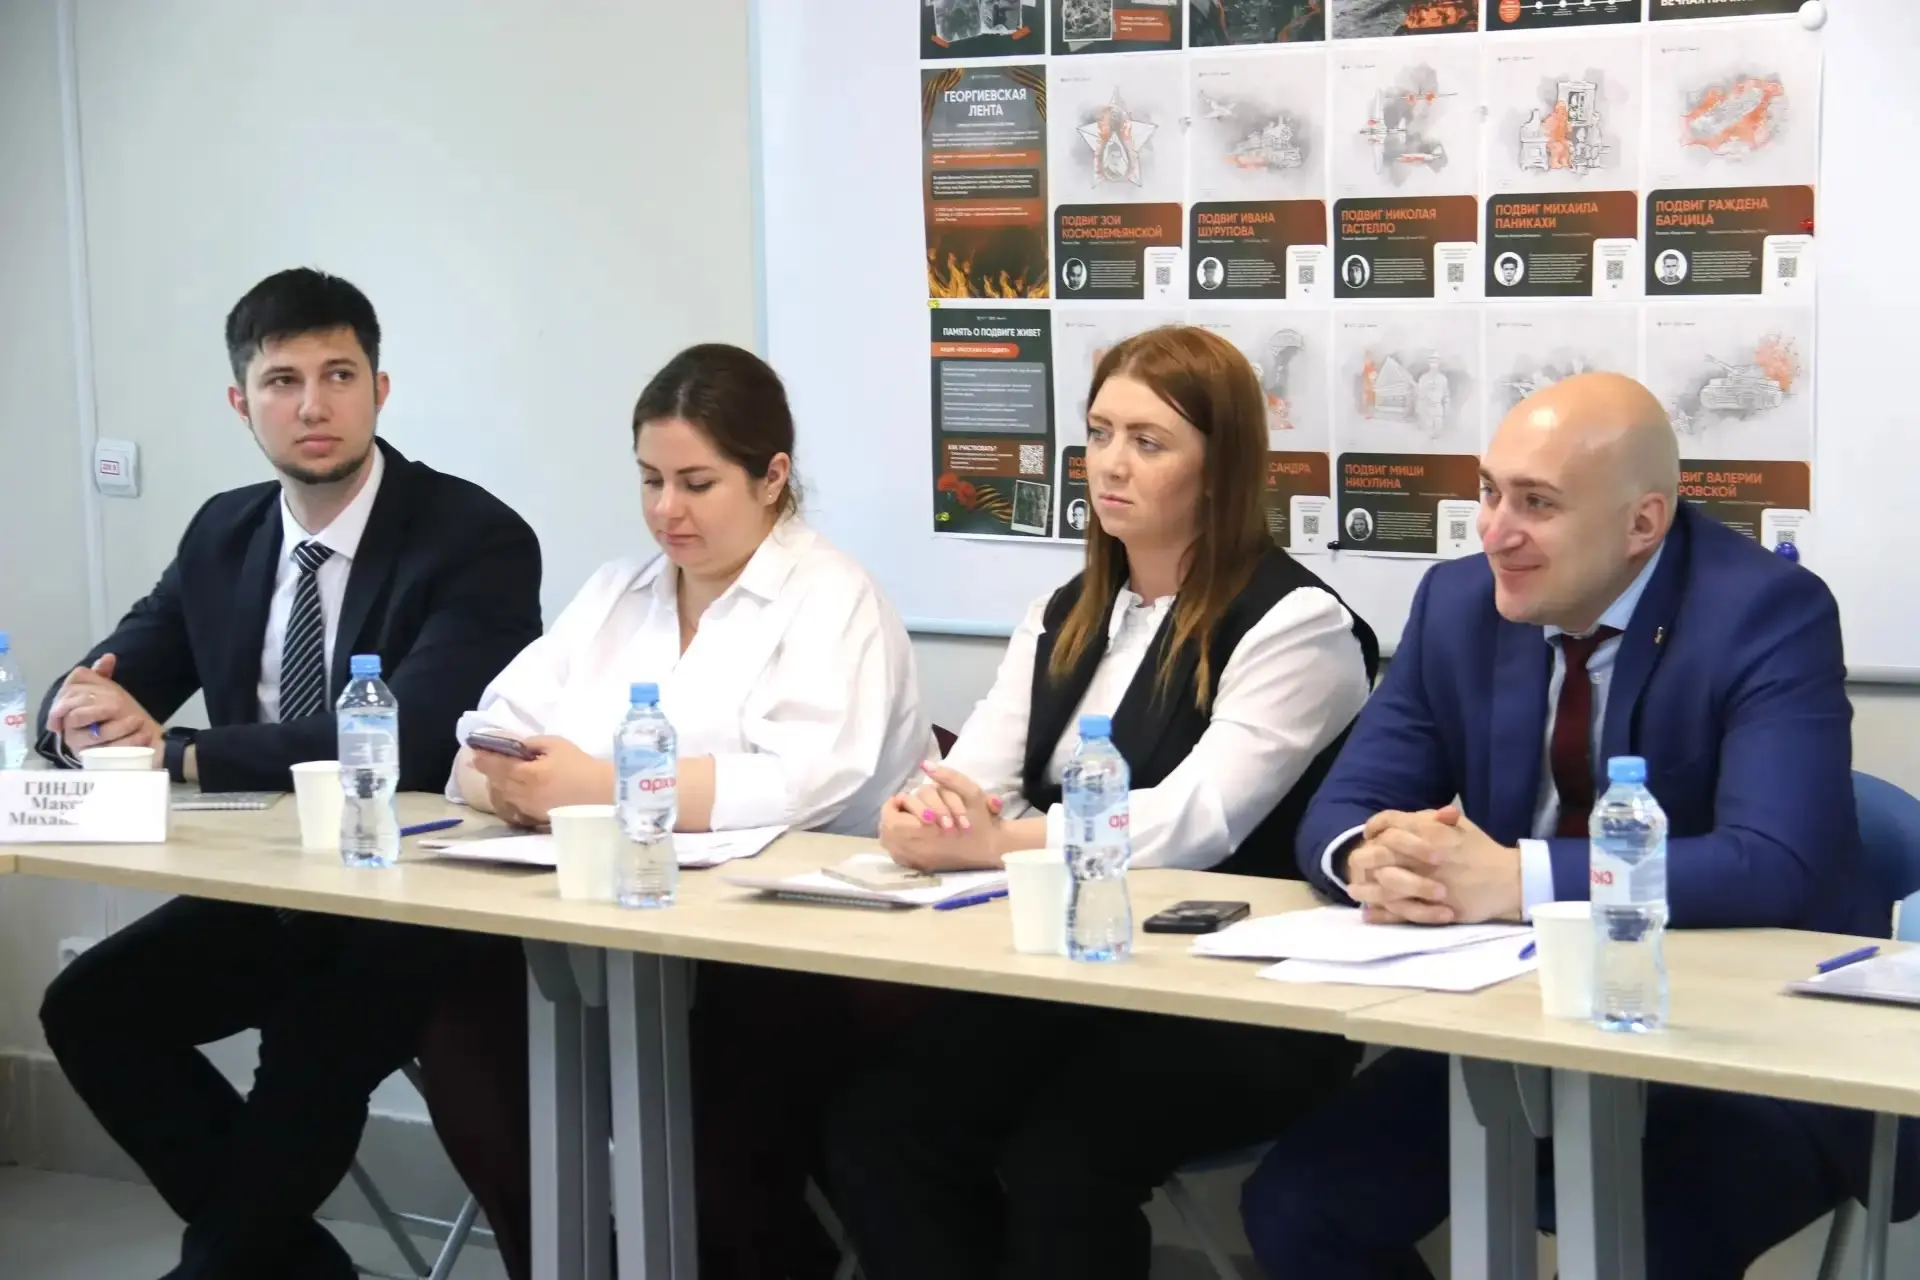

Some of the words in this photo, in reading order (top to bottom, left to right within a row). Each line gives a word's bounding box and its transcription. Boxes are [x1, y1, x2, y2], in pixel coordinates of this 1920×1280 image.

[944, 88, 1027, 103] ГЕОРГИЕВСКАЯ
[968, 104, 1004, 116] ЛЕНТА
[1495, 204, 1541, 216] ПОДВИГ
[1543, 202, 1599, 214] МИХАИЛА
[1655, 200, 1706, 213] ПОДВИГ
[1708, 198, 1769, 212] РАЖДЕНА
[1062, 216, 1098, 226] ПОДВИГ
[1101, 216, 1121, 225] ЗОИ
[1198, 213, 1238, 224] ПОДВИГ
[1241, 212, 1275, 224] ИВАНА
[1341, 210, 1382, 222] ПОДВИГ
[1385, 208, 1437, 220] НИКОЛАЯ
[1655, 214, 1714, 227] БАРЦИЦА
[1341, 223, 1396, 234] ГАСТЕЛЛО
[1495, 217, 1557, 229] ПАНИКАХИ
[1062, 225, 1162, 239] КОСМОДЕМЬЯНСКОЙ
[1198, 226, 1255, 237] ШУРУПОВА
[943, 328, 973, 337] ПАМЯТЬ
[973, 328, 980, 337] О
[981, 328, 1015, 338] ПОДВИГЕ
[1016, 328, 1041, 337] ЖИВЕТ
[1268, 462, 1312, 474] САНДРА
[1345, 464, 1386, 476] ПОДВИГ
[1389, 465, 1424, 476] МИШИ
[1345, 477, 1402, 488] НИКУЛИНА
[1679, 472, 1704, 483] ВИГ
[1706, 472, 1763, 484] ВАЛЕРИИ
[1679, 484, 1737, 497] РОВСКОЙ
